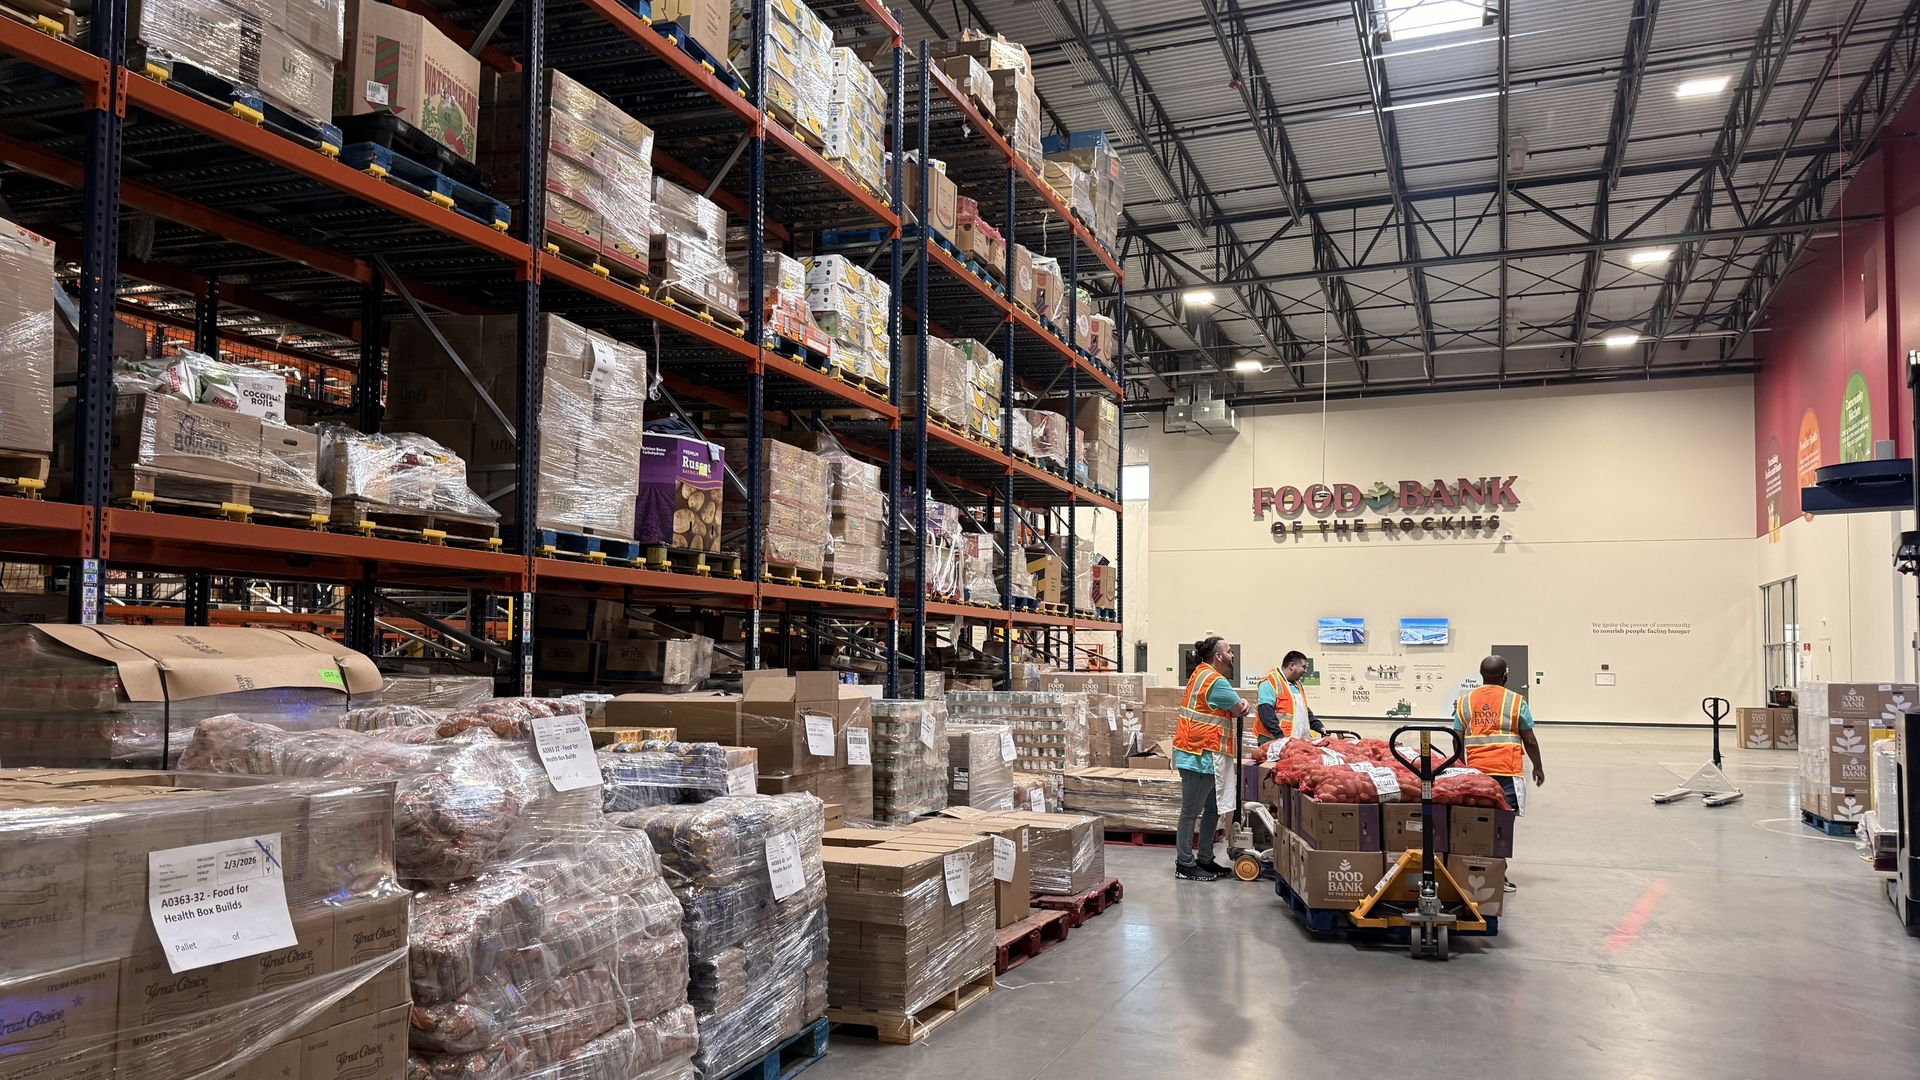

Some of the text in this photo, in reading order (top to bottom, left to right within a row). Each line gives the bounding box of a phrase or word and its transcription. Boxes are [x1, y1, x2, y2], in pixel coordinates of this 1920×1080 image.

[425, 61, 477, 128] WATERMELON
[683, 449, 699, 457] PREMIUM
[1253, 476, 1521, 517] FOOD BANK
[1272, 515, 1500, 535] OF THE ROCKIES
[224, 857, 257, 870] 2/3/2026
[1327, 871, 1363, 882] FOOD
[1328, 882, 1364, 893] BANK
[161, 892, 205, 908] A0363-32
[212, 886, 235, 898] Food
[236, 884, 249, 895] for
[2, 912, 73, 929] VEGETABLES
[164, 900, 243, 923] Health Box Builds
[175, 931, 240, 953] Pallet of
[353, 927, 399, 949] Great Choice
[259, 949, 313, 975] Great Choice
[144, 975, 209, 1003] Great Choice
[26, 1009, 65, 1029] Choice
[336, 1044, 383, 1070] Great Choice
